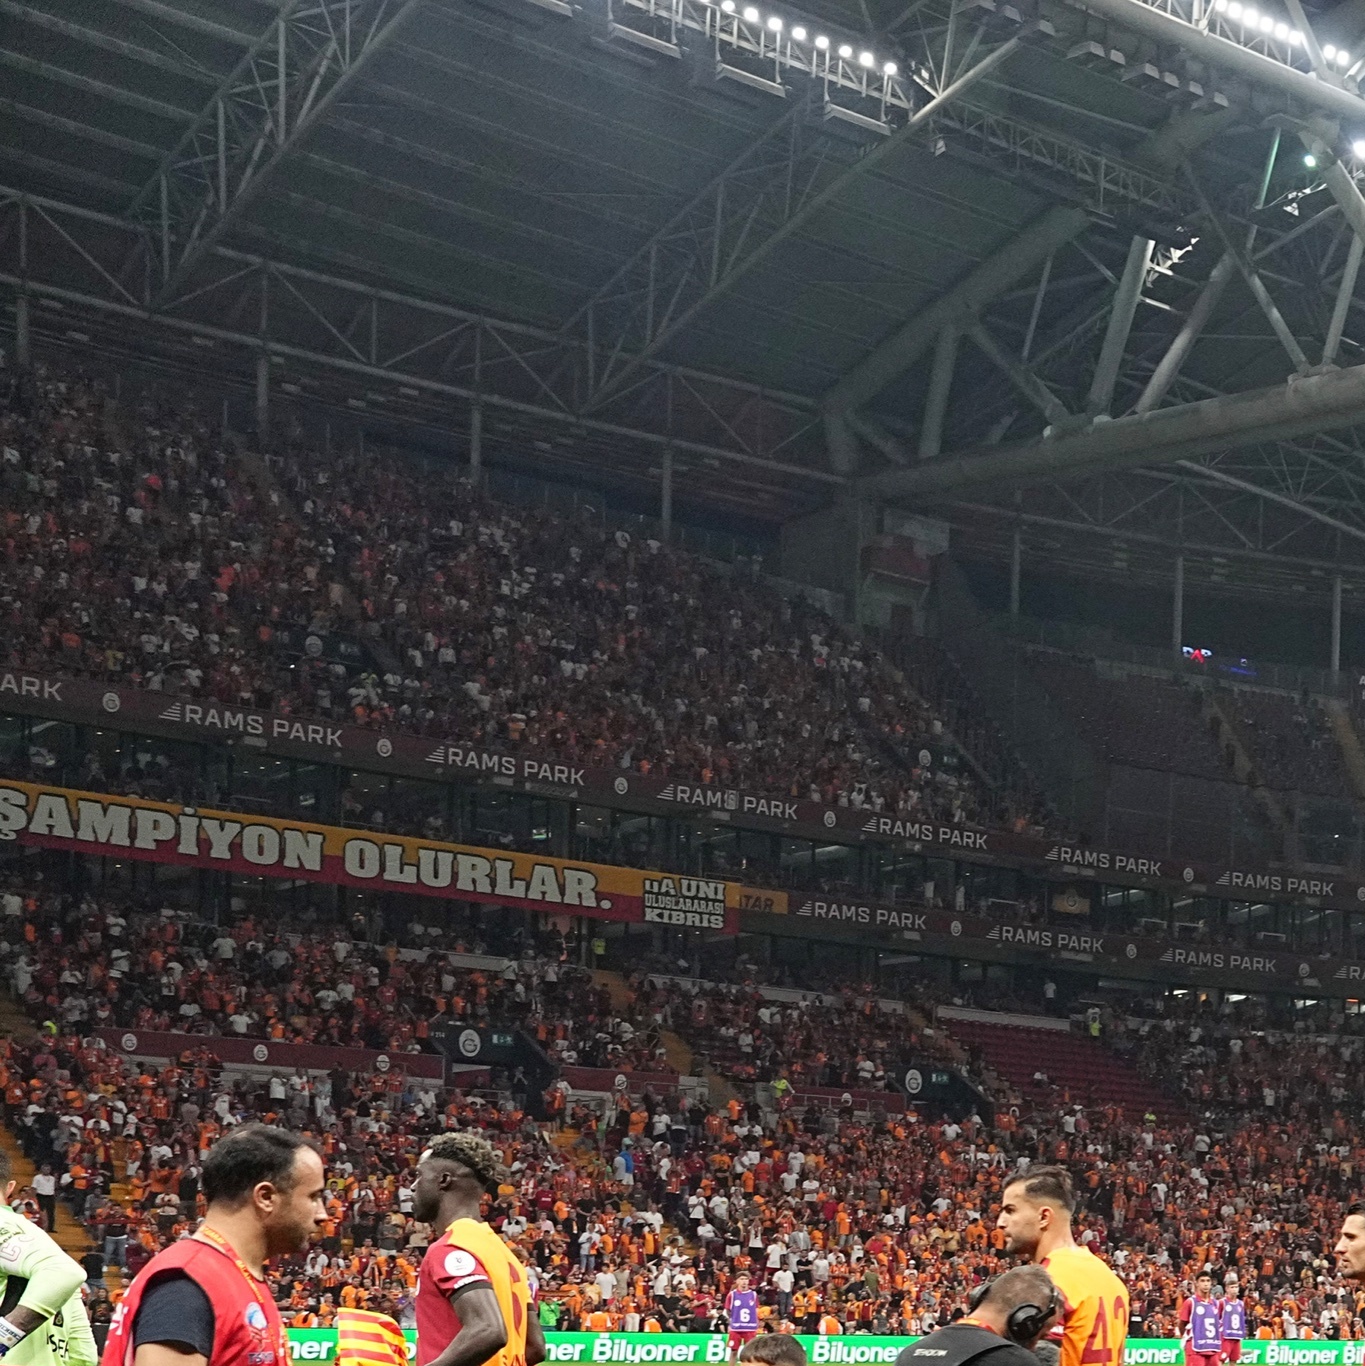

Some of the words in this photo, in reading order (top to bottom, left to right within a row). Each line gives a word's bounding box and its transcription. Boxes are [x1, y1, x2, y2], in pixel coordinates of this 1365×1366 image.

[185, 704, 264, 734] RAMS
[272, 718, 344, 747] PARK
[448, 747, 516, 775] RAMS
[524, 760, 585, 786] PARK
[744, 798, 798, 820] PARK
[879, 818, 933, 841] RAMS
[938, 828, 988, 849] PARK
[0, 788, 324, 872] ŞAMPİYON
[343, 836, 613, 911] OLURLAR.
[1060, 847, 1110, 868] RAMS
[1116, 856, 1161, 877] PARK
[1231, 872, 1282, 891] RAMS
[1287, 878, 1334, 897] PARK
[644, 893, 724, 915] ULUSLARARASI
[814, 902, 870, 924] RAMS
[876, 909, 926, 930] PARK
[644, 907, 724, 929] KIBRIS
[1002, 926, 1052, 947] RAMS
[1057, 932, 1104, 953] PARK
[1174, 949, 1225, 969] RAMS
[1230, 955, 1277, 973] PARK
[740, 1307, 751, 1323] 6
[1204, 1317, 1216, 1338] 5
[1231, 1313, 1240, 1330] 8
[591, 1334, 700, 1363] Bilyoner
[1265, 1341, 1339, 1366] Bilyoner
